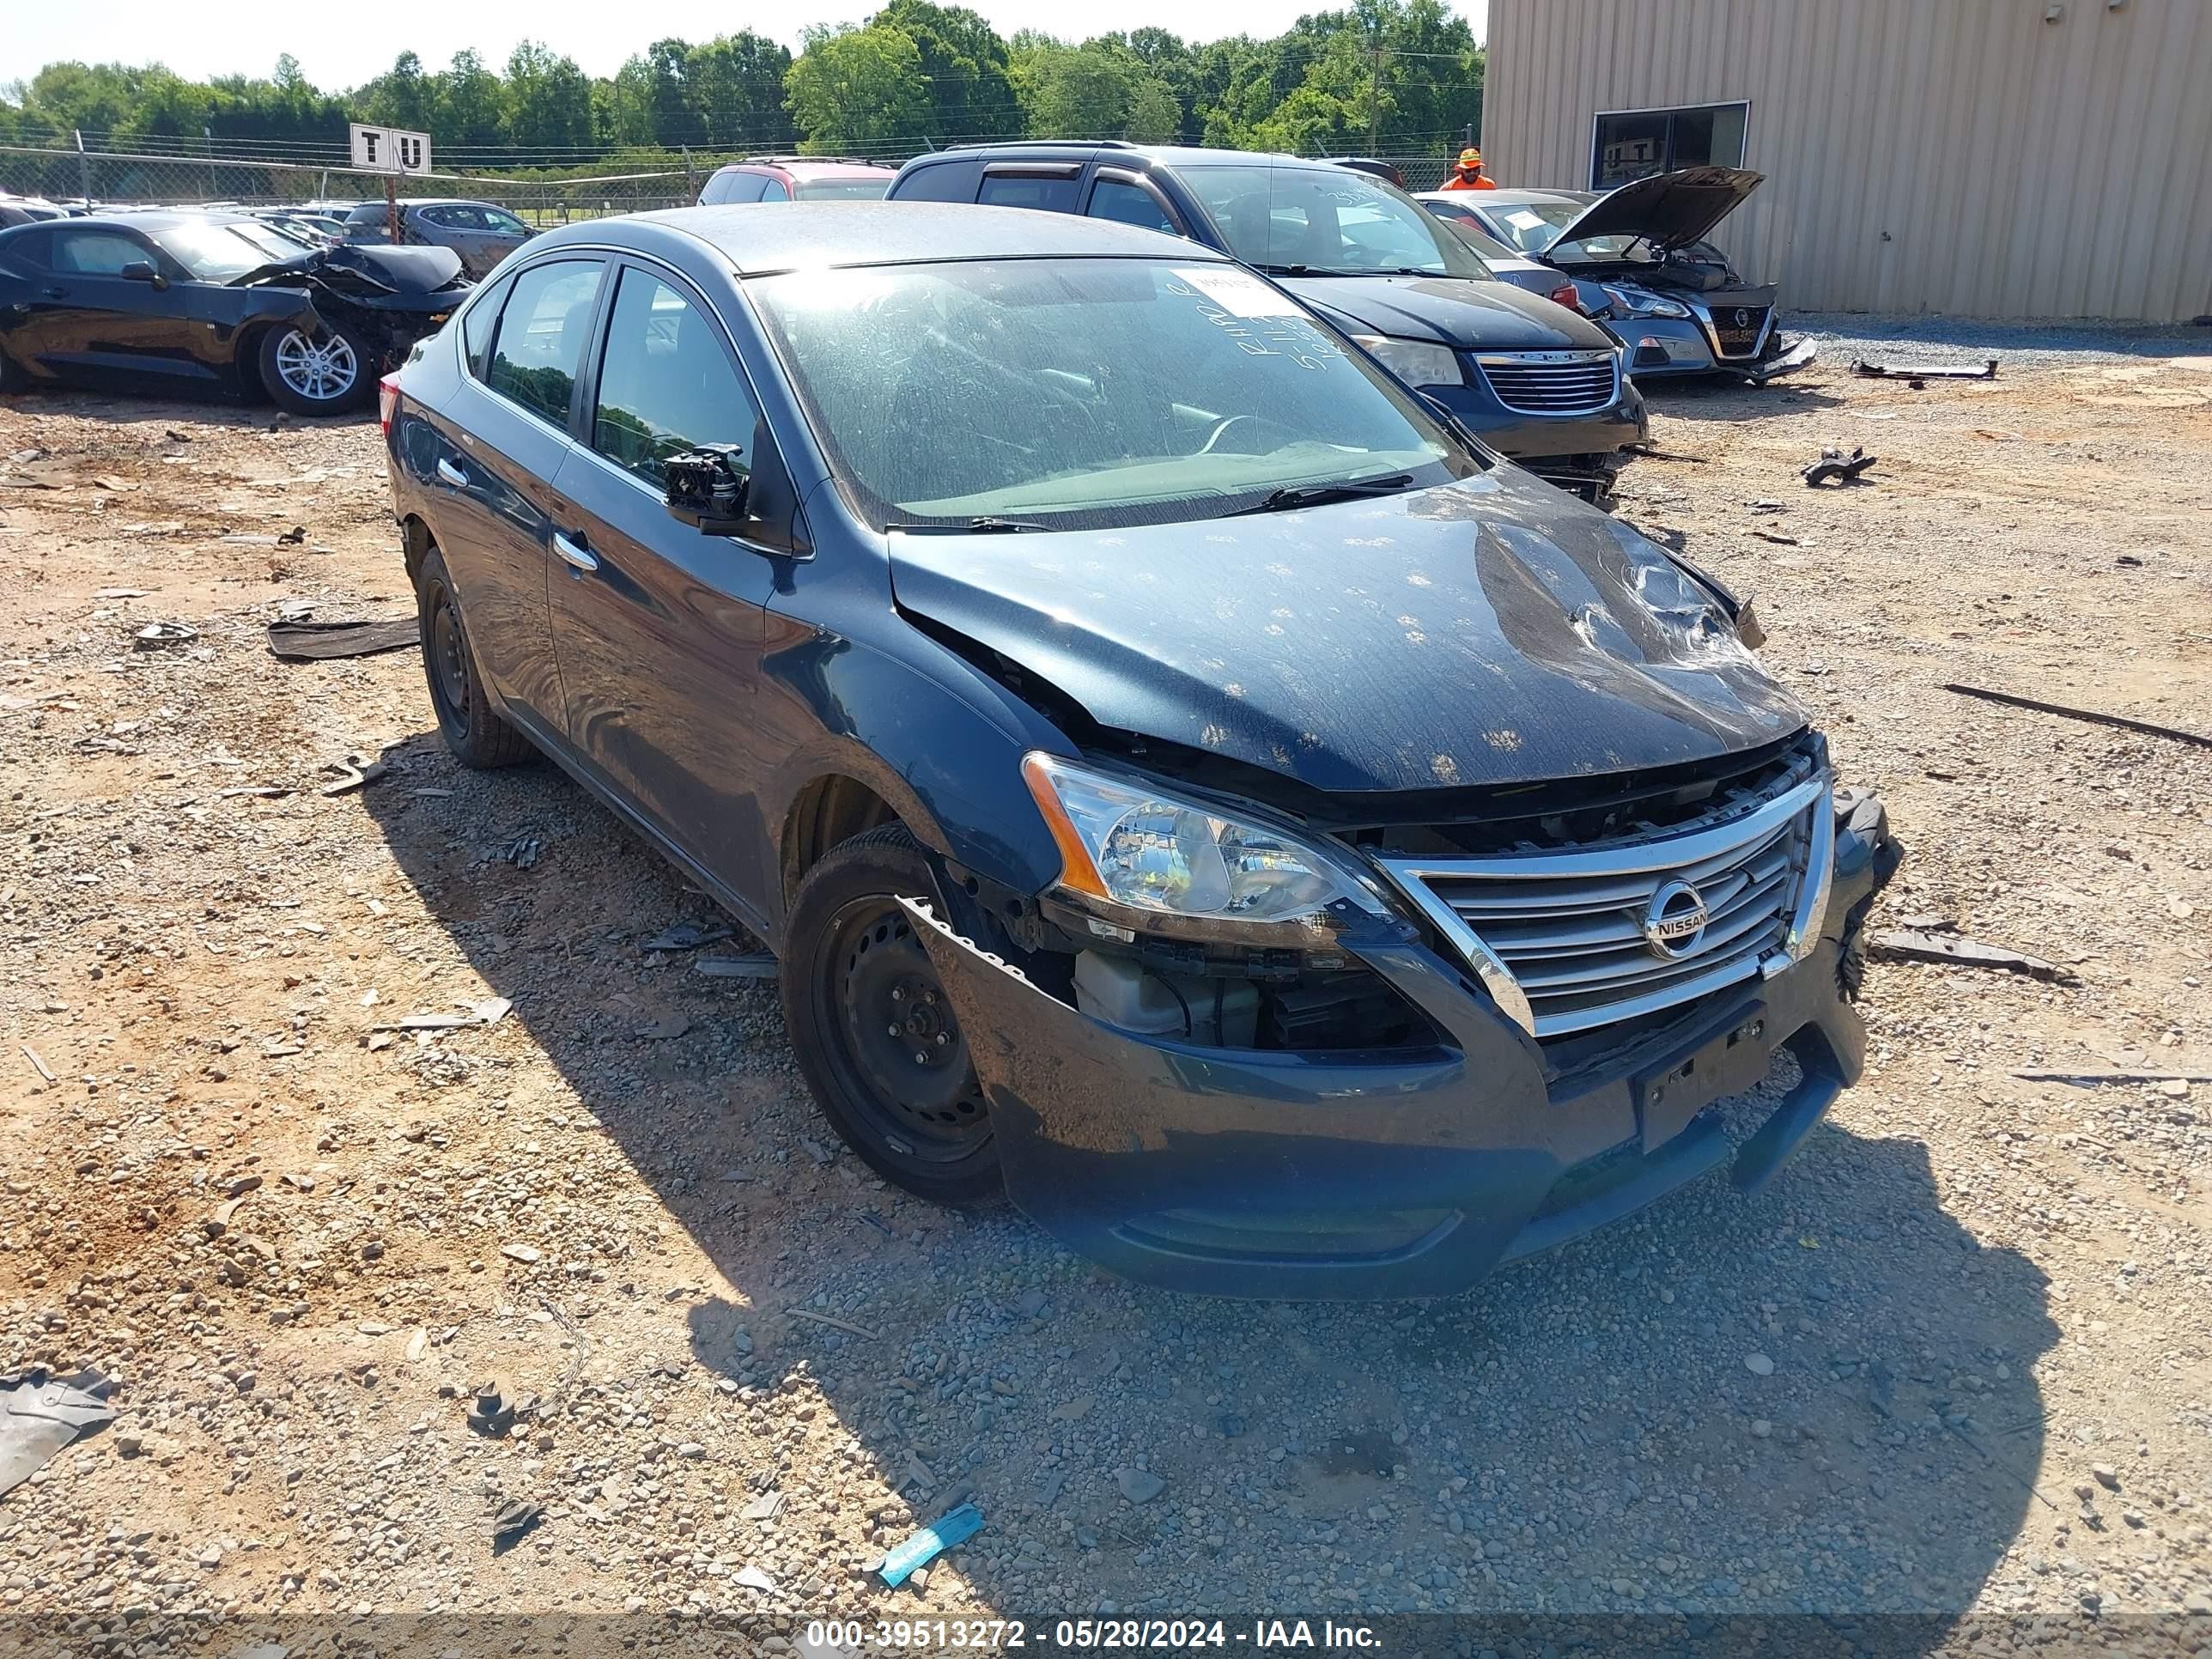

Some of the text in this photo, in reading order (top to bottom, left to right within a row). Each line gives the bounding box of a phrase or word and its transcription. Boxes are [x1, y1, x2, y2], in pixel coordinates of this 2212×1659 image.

[362, 131, 421, 168] T U
[1658, 913, 1706, 936] NISSAN
